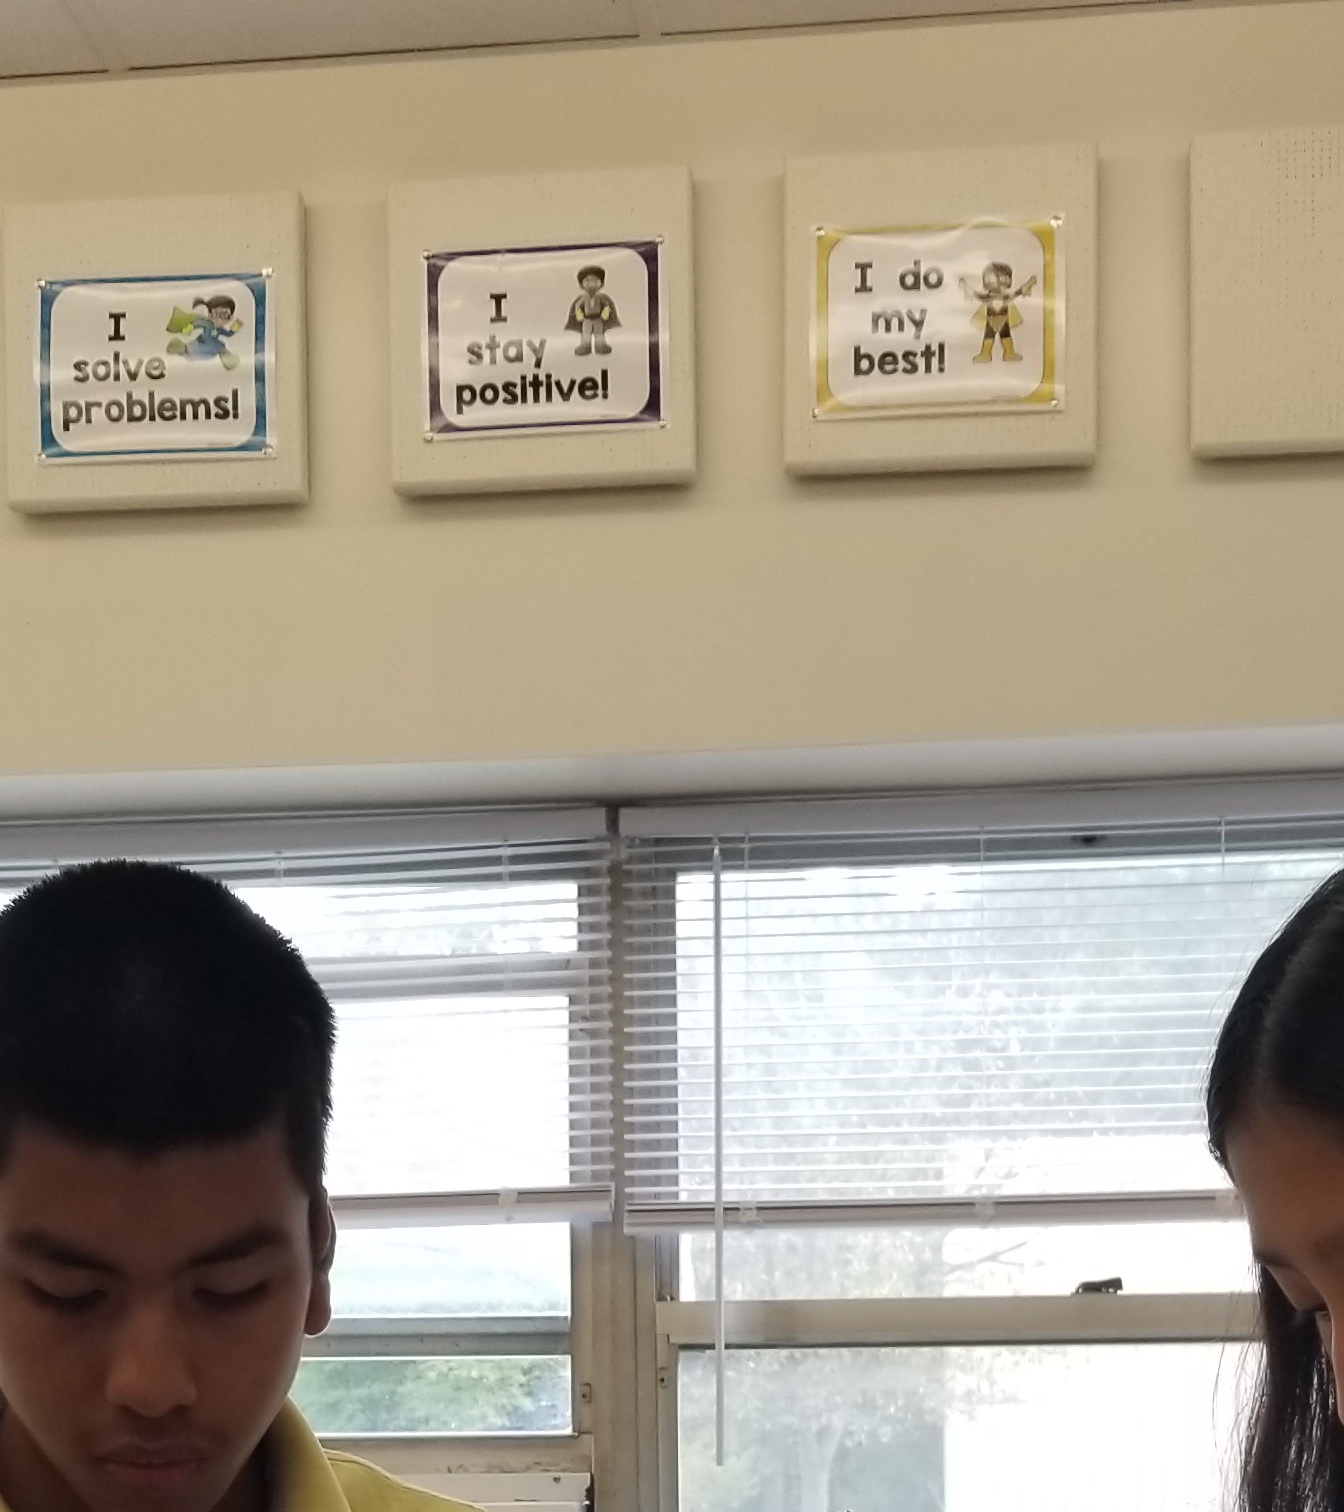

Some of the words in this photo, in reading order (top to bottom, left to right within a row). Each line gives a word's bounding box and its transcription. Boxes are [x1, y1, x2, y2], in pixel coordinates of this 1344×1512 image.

[854, 262, 874, 293] I
[898, 260, 945, 292] do
[489, 293, 508, 323] I
[871, 308, 927, 340] my
[108, 312, 127, 342] I
[72, 351, 168, 384] solve
[466, 335, 547, 369] stay
[853, 343, 947, 377] best!
[455, 367, 610, 414] positive!
[61, 388, 241, 432] problems!
